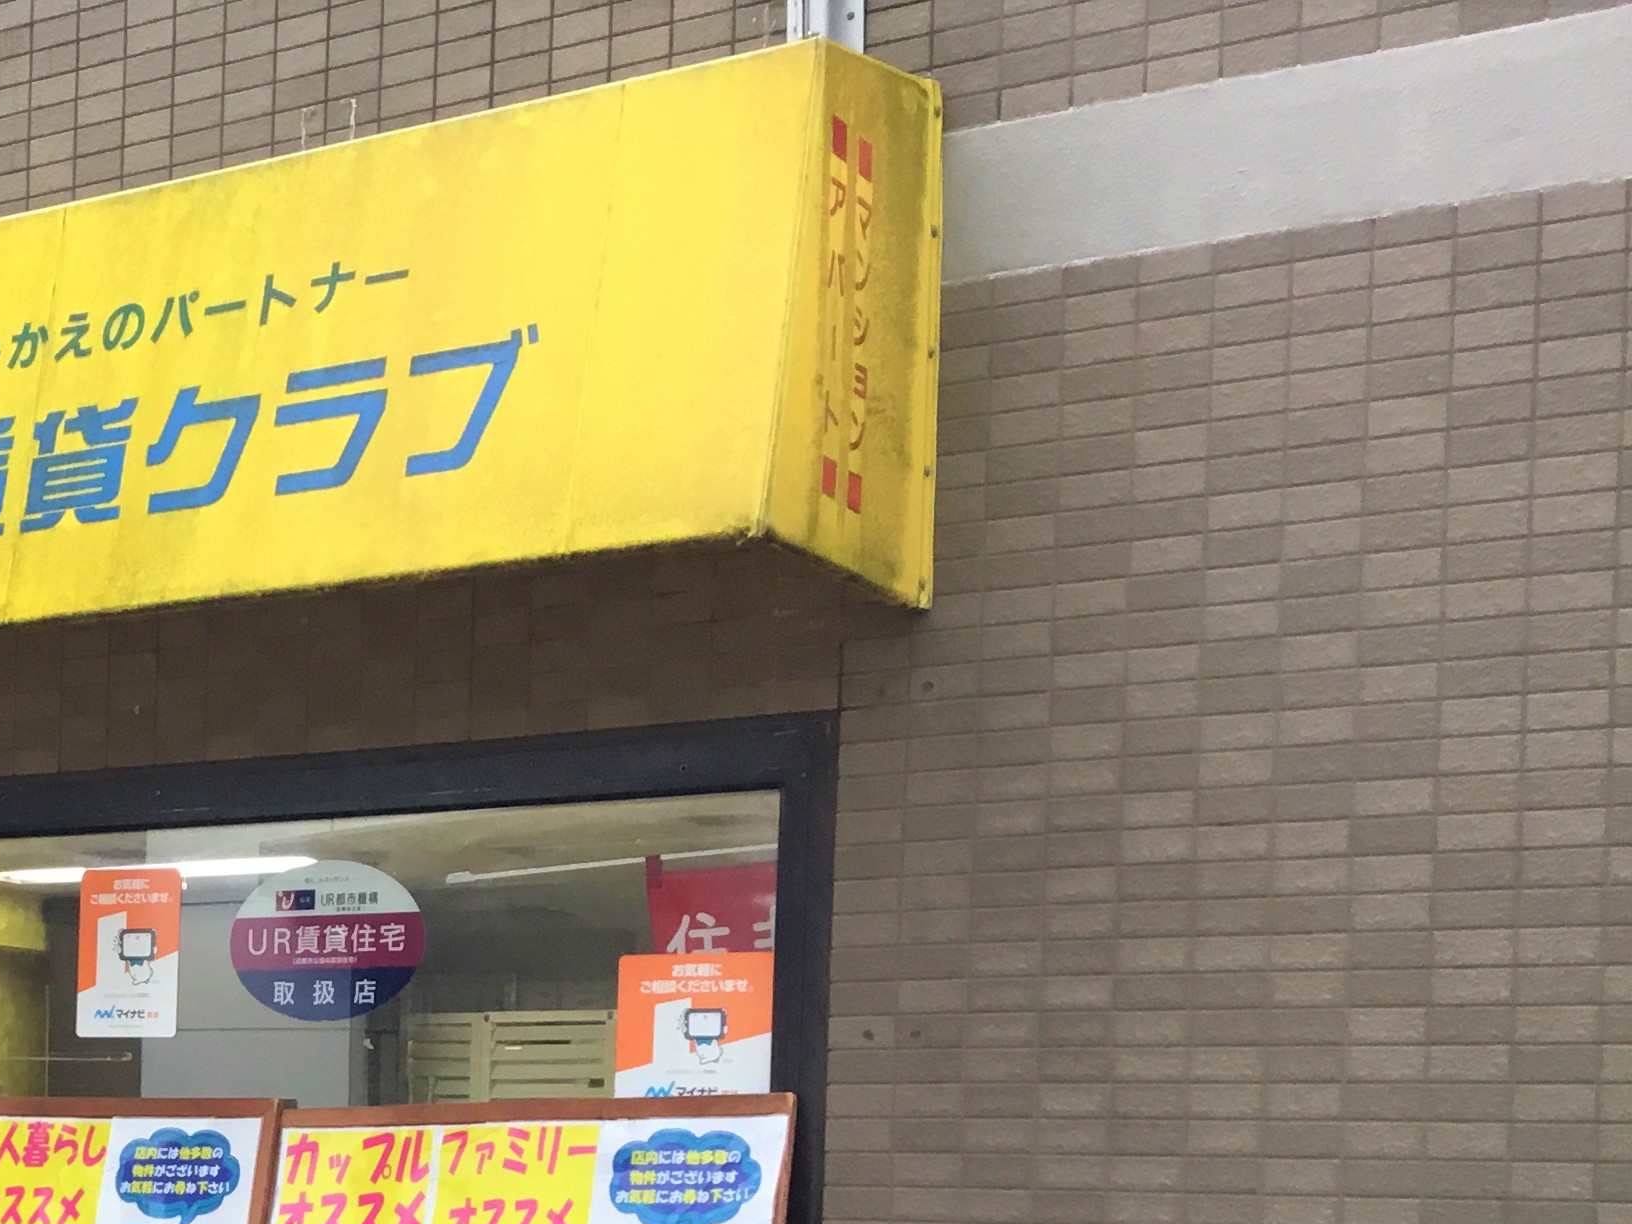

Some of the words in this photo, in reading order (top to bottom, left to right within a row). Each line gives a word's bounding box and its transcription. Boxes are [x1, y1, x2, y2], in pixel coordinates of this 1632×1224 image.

[825, 177, 847, 434] アパート
[849, 196, 871, 450] マンション
[248, 922, 406, 956] UR賃貸住宅
[286, 1129, 430, 1185] カップル
[442, 1125, 597, 1175] ファミリー
